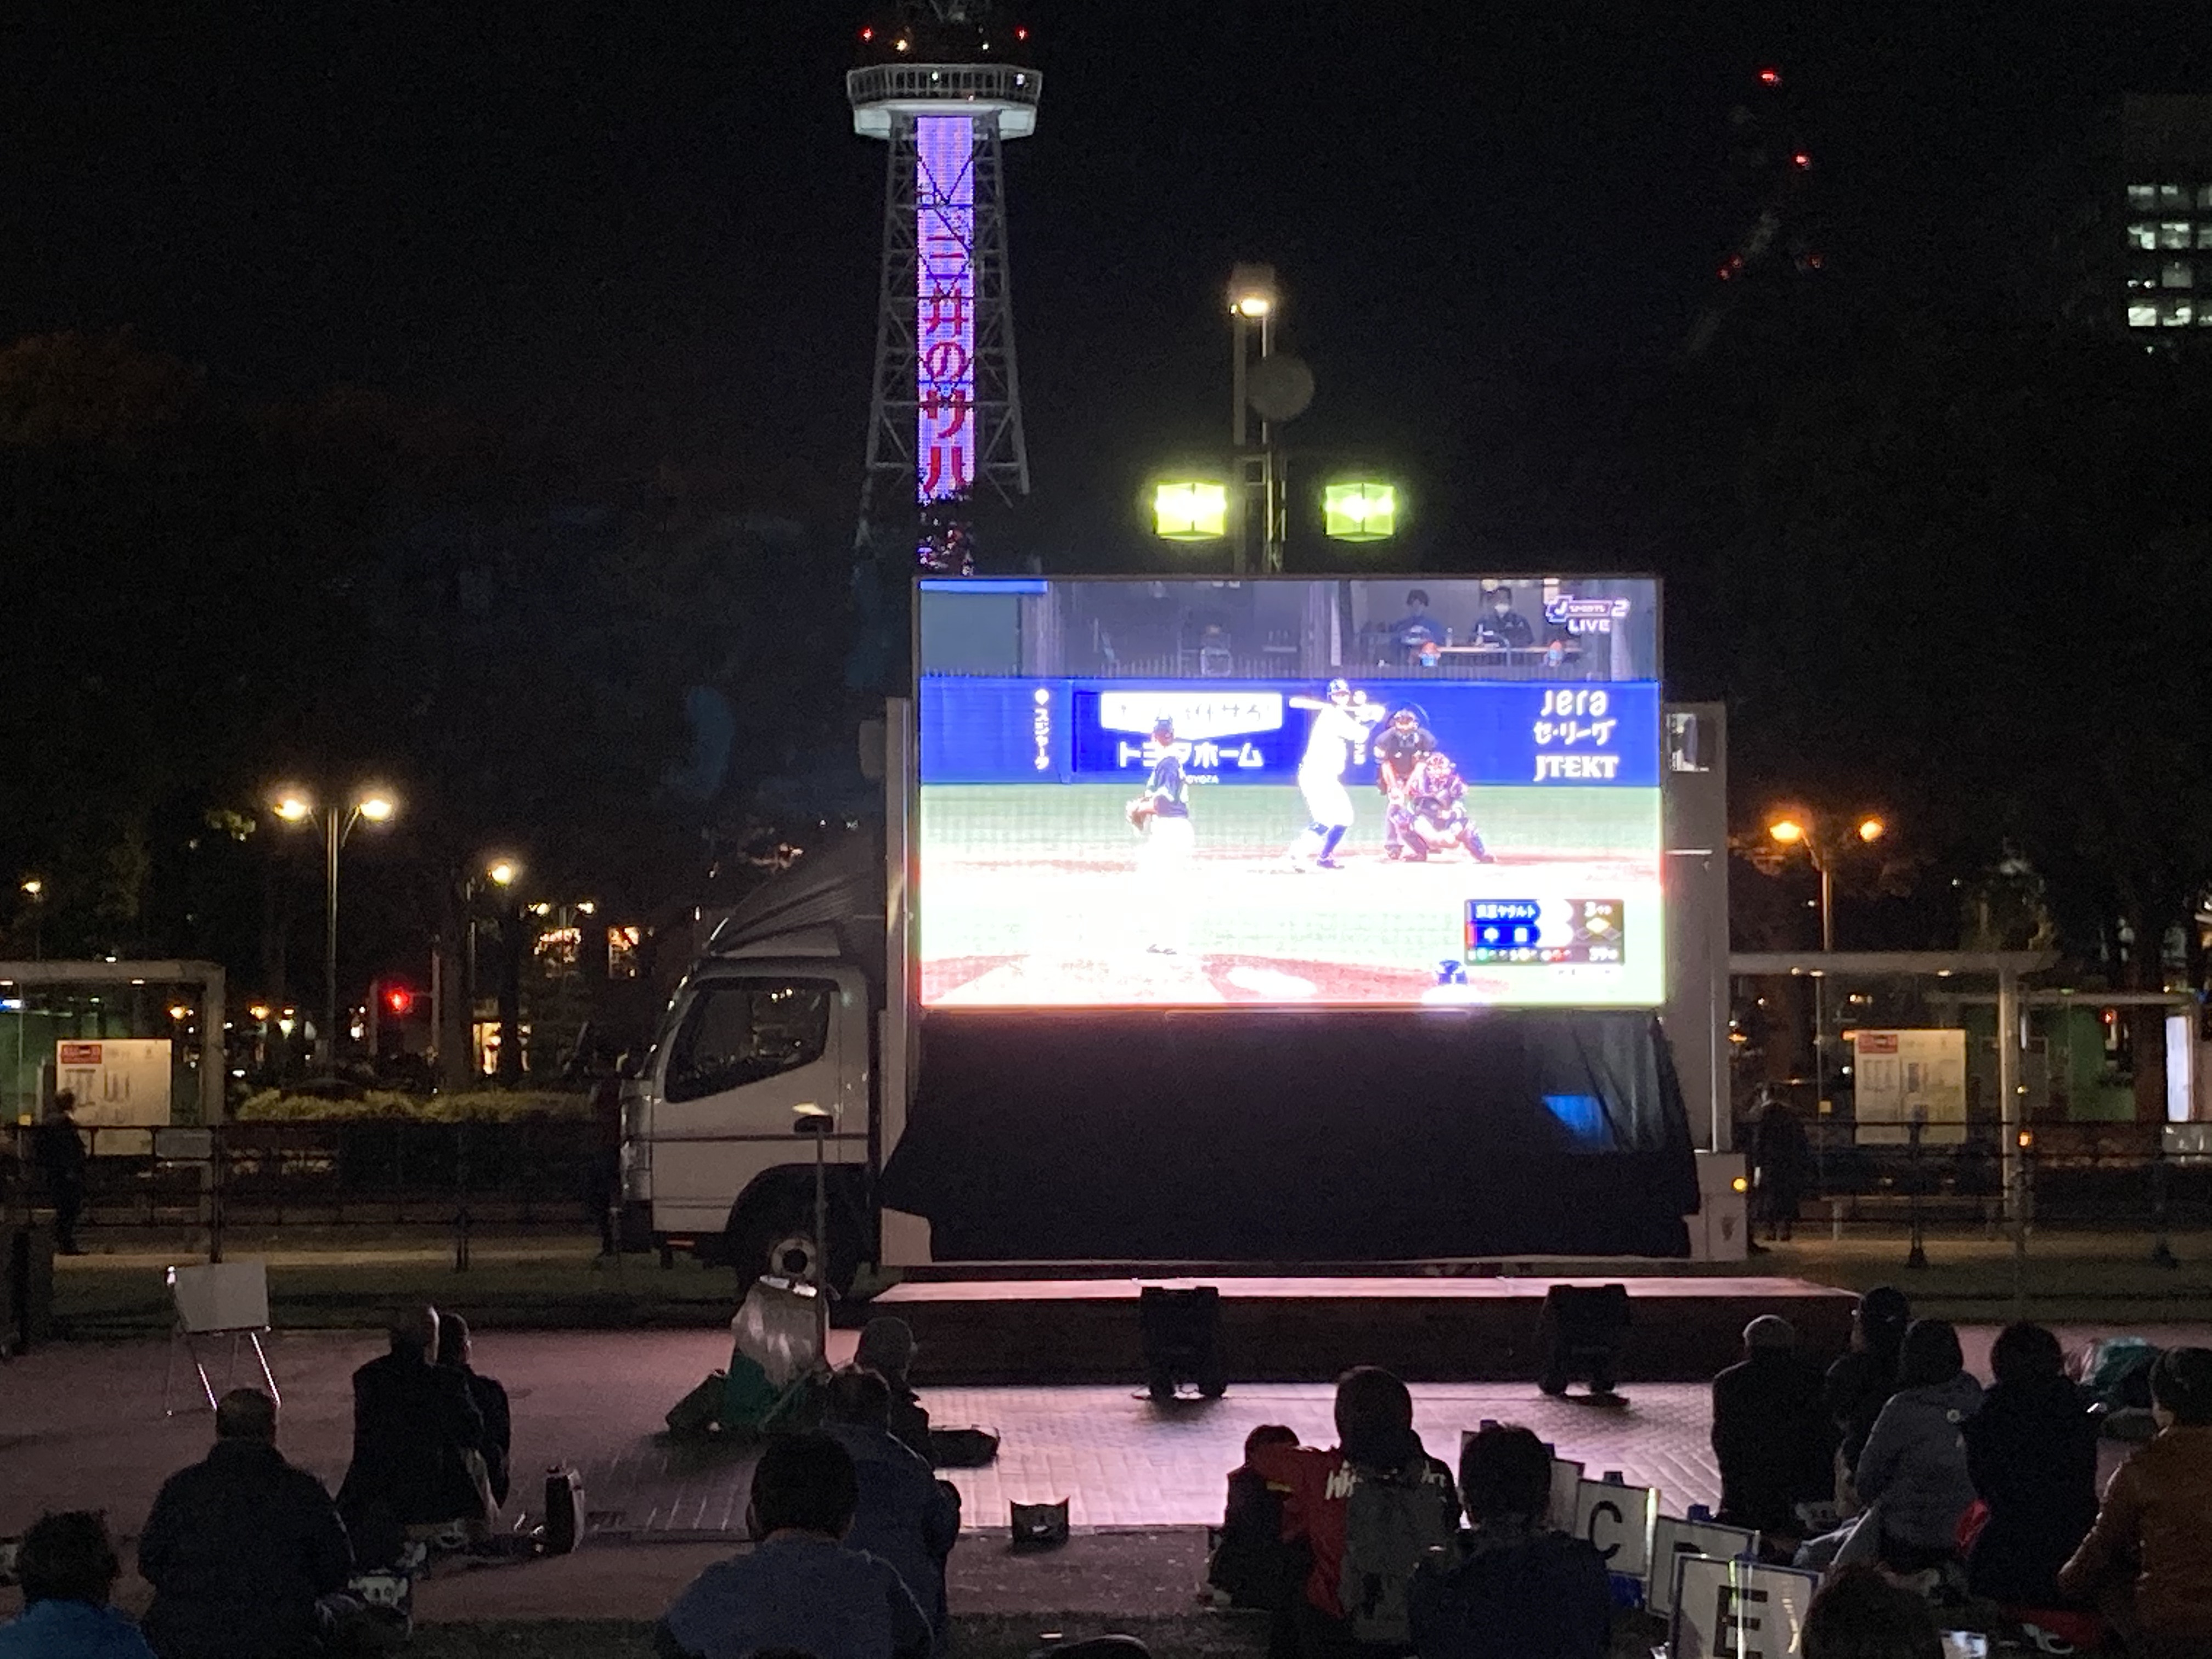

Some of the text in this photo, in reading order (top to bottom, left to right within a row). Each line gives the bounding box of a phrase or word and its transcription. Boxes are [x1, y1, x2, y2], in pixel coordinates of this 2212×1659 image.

[1611, 600, 1630, 617] 2
[1568, 619, 1610, 634] LIVE
[1532, 755, 1620, 782] JTEKT
[1588, 1500, 1622, 1560] C
[1713, 1585, 1768, 1659] E
